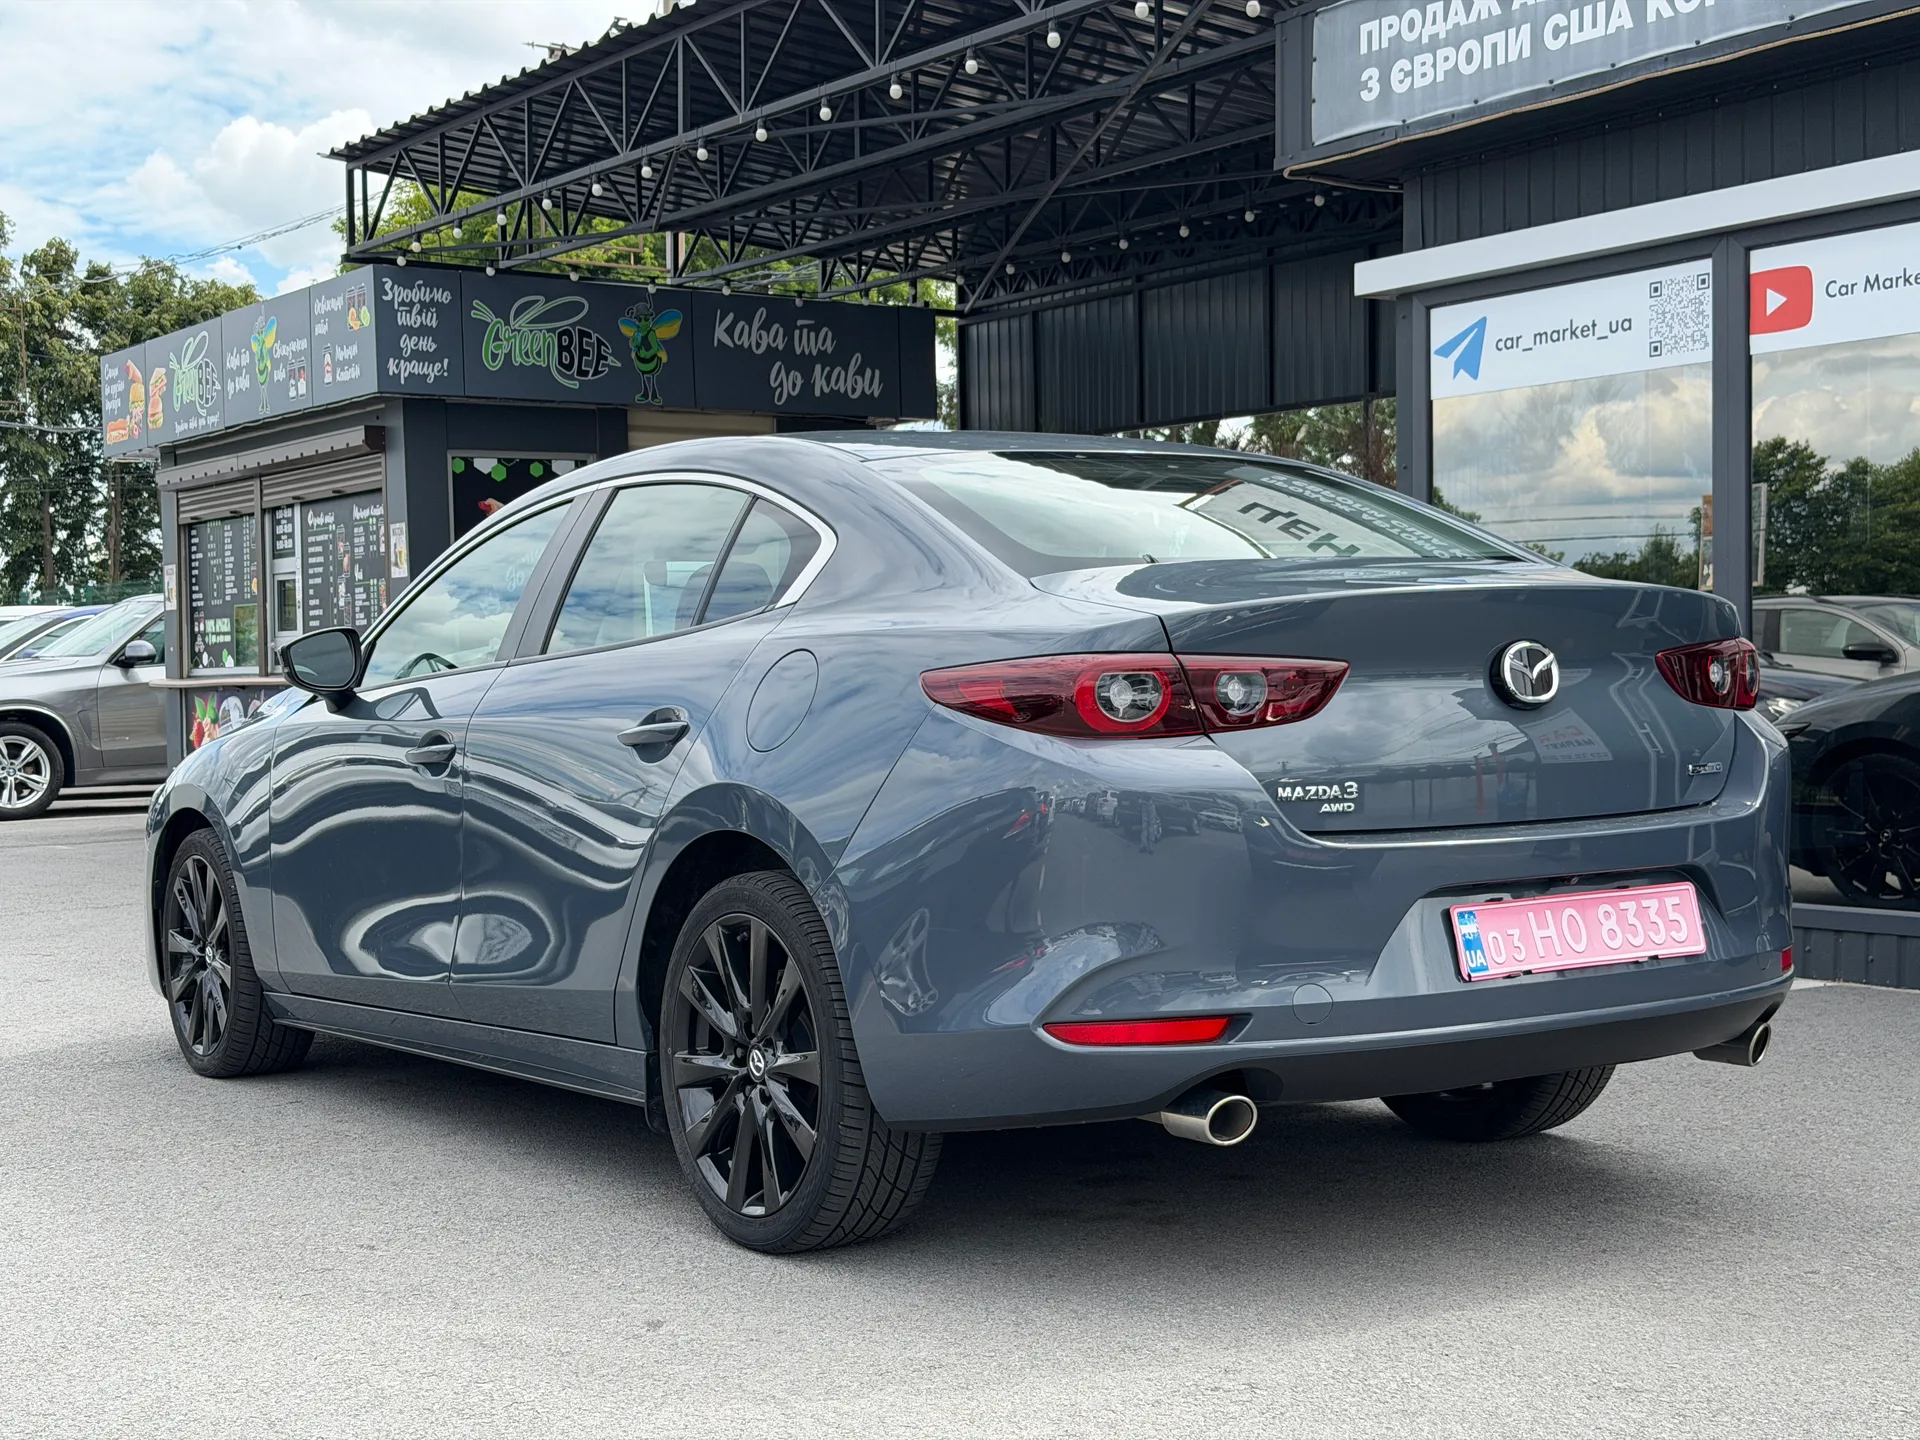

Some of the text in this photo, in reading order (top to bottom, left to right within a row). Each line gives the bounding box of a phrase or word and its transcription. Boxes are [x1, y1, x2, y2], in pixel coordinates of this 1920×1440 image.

[1360, 0, 1502, 55] ПРОДАЖ
[1360, 67, 1380, 102] З
[1390, 22, 1531, 94] ЄВРОПИ
[1543, 0, 1634, 50] США
[382, 278, 452, 310] Зробимо
[1825, 280, 1858, 298] Car
[397, 303, 438, 328] твій
[400, 333, 437, 357] день
[714, 307, 836, 356] Кава та
[1495, 318, 1632, 352] car_market_ua
[387, 358, 449, 384] краще!
[769, 352, 883, 405] до кави
[1277, 782, 1359, 801] MAZDA3
[1319, 803, 1355, 813] AWD
[1487, 897, 1688, 964] 03 HO 8335
[1466, 950, 1487, 968] UA
